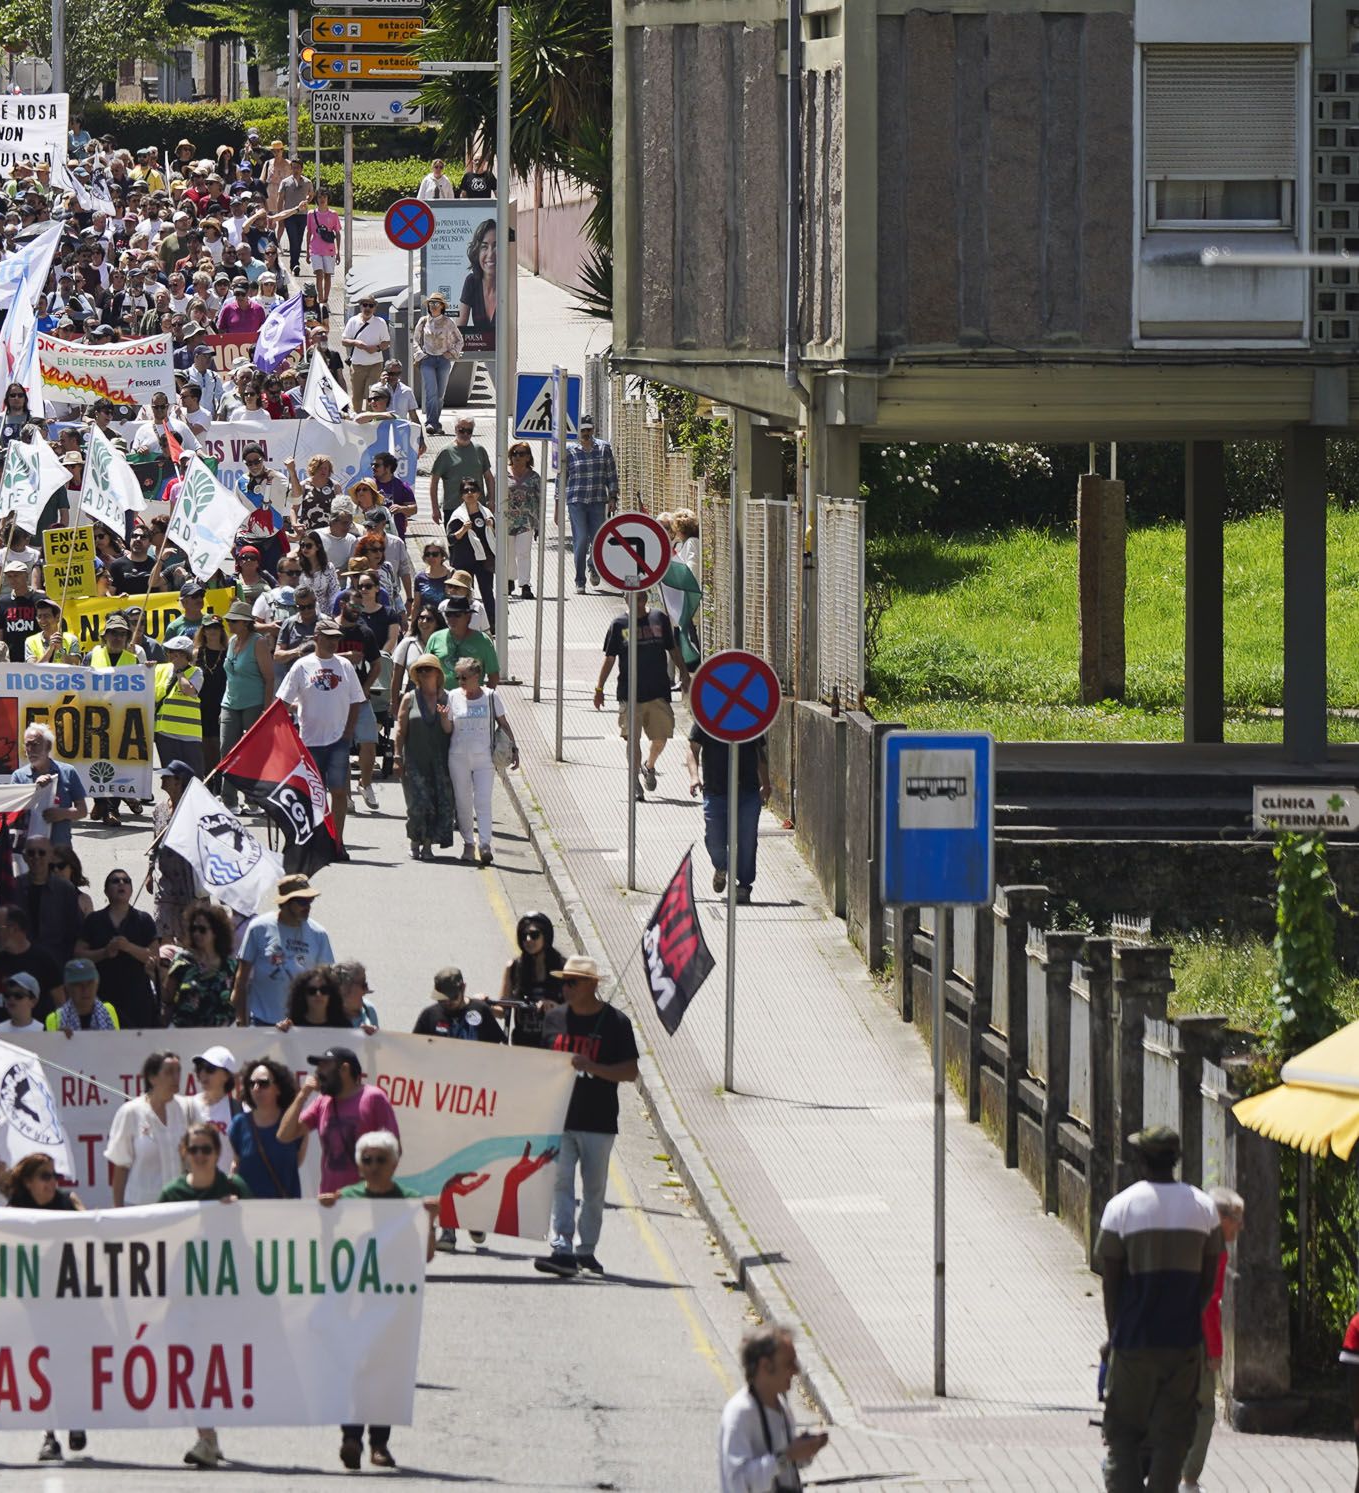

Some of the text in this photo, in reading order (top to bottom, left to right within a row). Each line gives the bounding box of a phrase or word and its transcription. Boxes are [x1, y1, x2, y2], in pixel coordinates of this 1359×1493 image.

[378, 21, 421, 30] estación
[378, 57, 420, 66] estación
[314, 91, 350, 102] MARÍN
[1, 100, 9, 120] É
[17, 103, 57, 121] NOSA
[314, 102, 341, 111] POIO
[314, 111, 376, 121] SANXENXO
[57, 357, 167, 369] EN DEFENSA DA TERRA
[135, 379, 161, 388] ERGUER
[82, 488, 125, 525] ADEG
[49, 529, 88, 543] ENCE
[50, 541, 89, 556] FÓRA
[170, 517, 211, 570] ADA
[58, 576, 83, 588] NON
[6, 619, 35, 633] NON
[6, 671, 87, 692] nosas
[88, 784, 136, 794] ADEGA
[1261, 794, 1315, 809] CLÍNICA
[279, 788, 314, 838] CGT
[61, 1070, 108, 1106] RÍA.
[434, 1082, 498, 1118] VIDA!
[55, 1241, 167, 1298] ALTRI
[185, 1239, 239, 1297] NA
[255, 1238, 418, 1296] ULLOA...
[92, 1322, 255, 1412] FÓRA!
